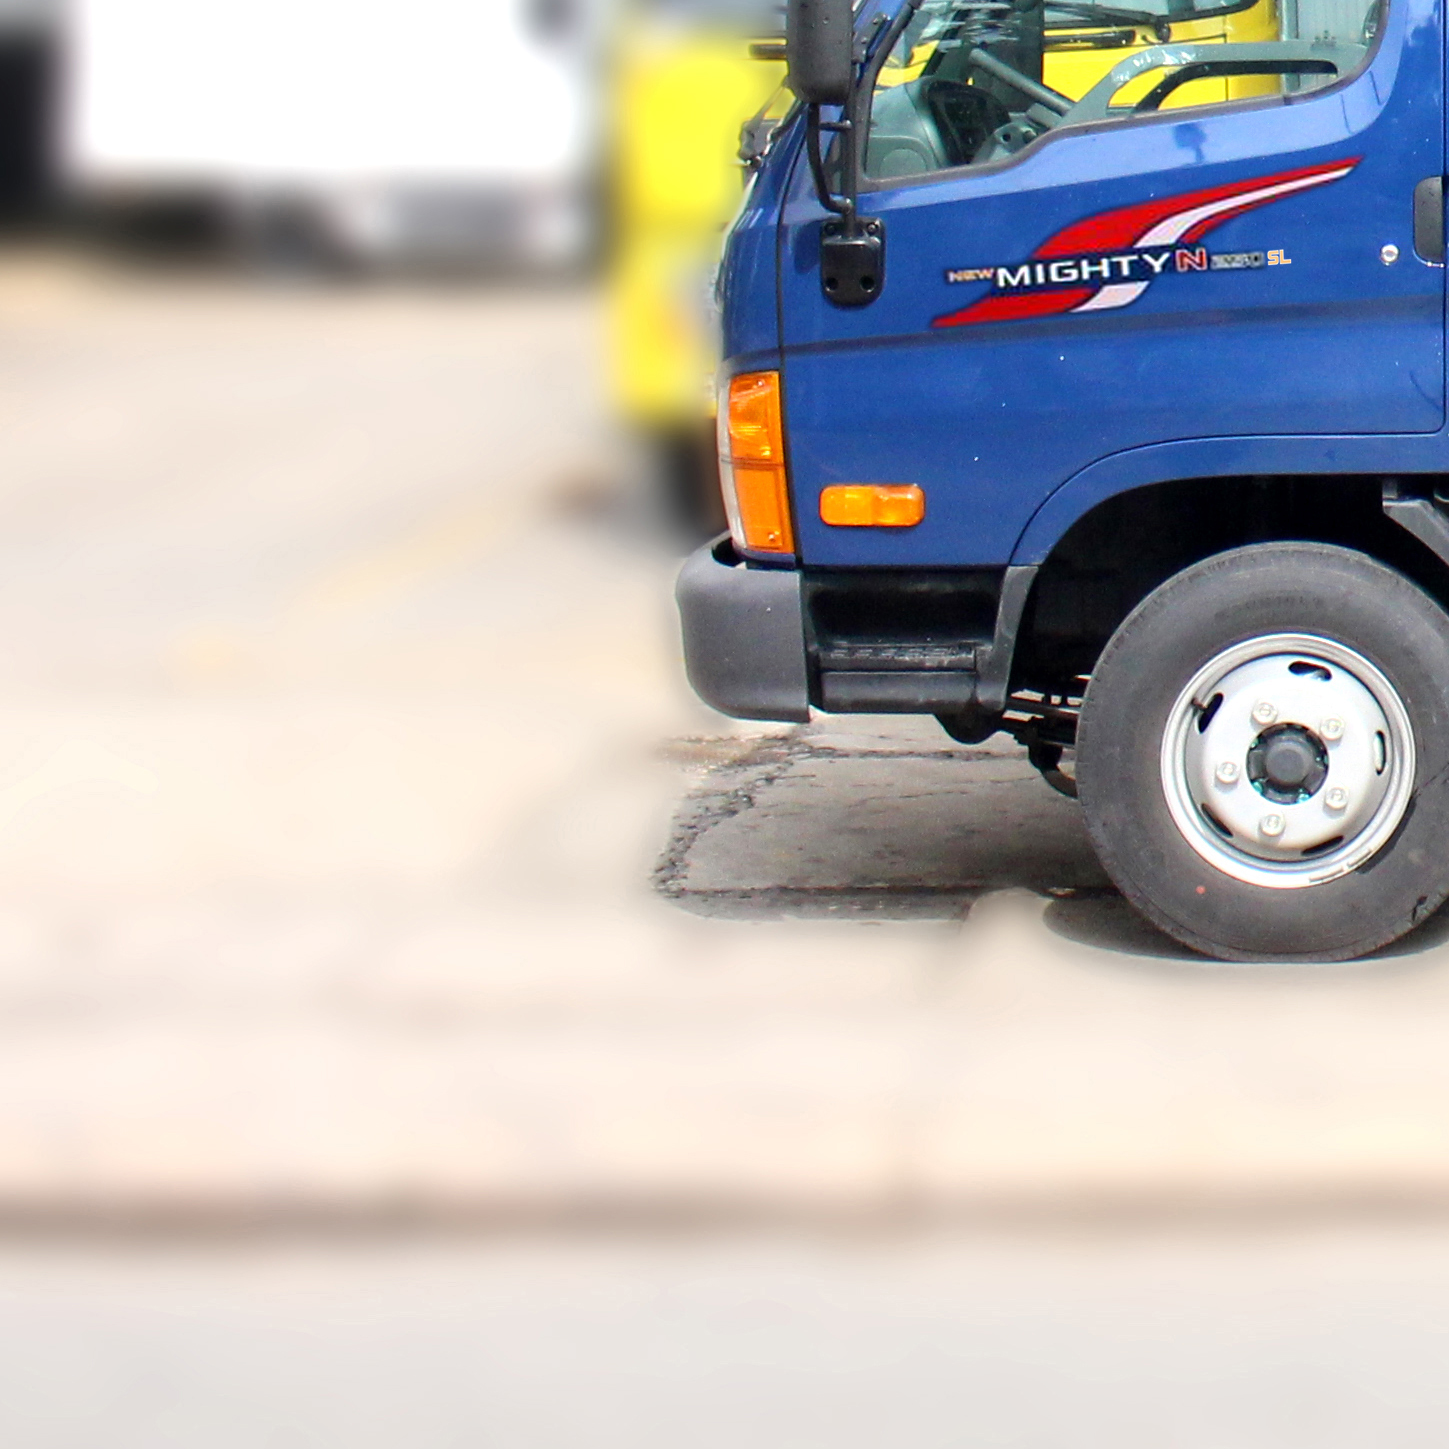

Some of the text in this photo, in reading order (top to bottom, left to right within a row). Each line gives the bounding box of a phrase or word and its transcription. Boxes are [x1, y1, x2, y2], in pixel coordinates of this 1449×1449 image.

[948, 267, 995, 283] NEW
[996, 252, 1171, 288] MIGHTY
[1266, 250, 1292, 266] SL
